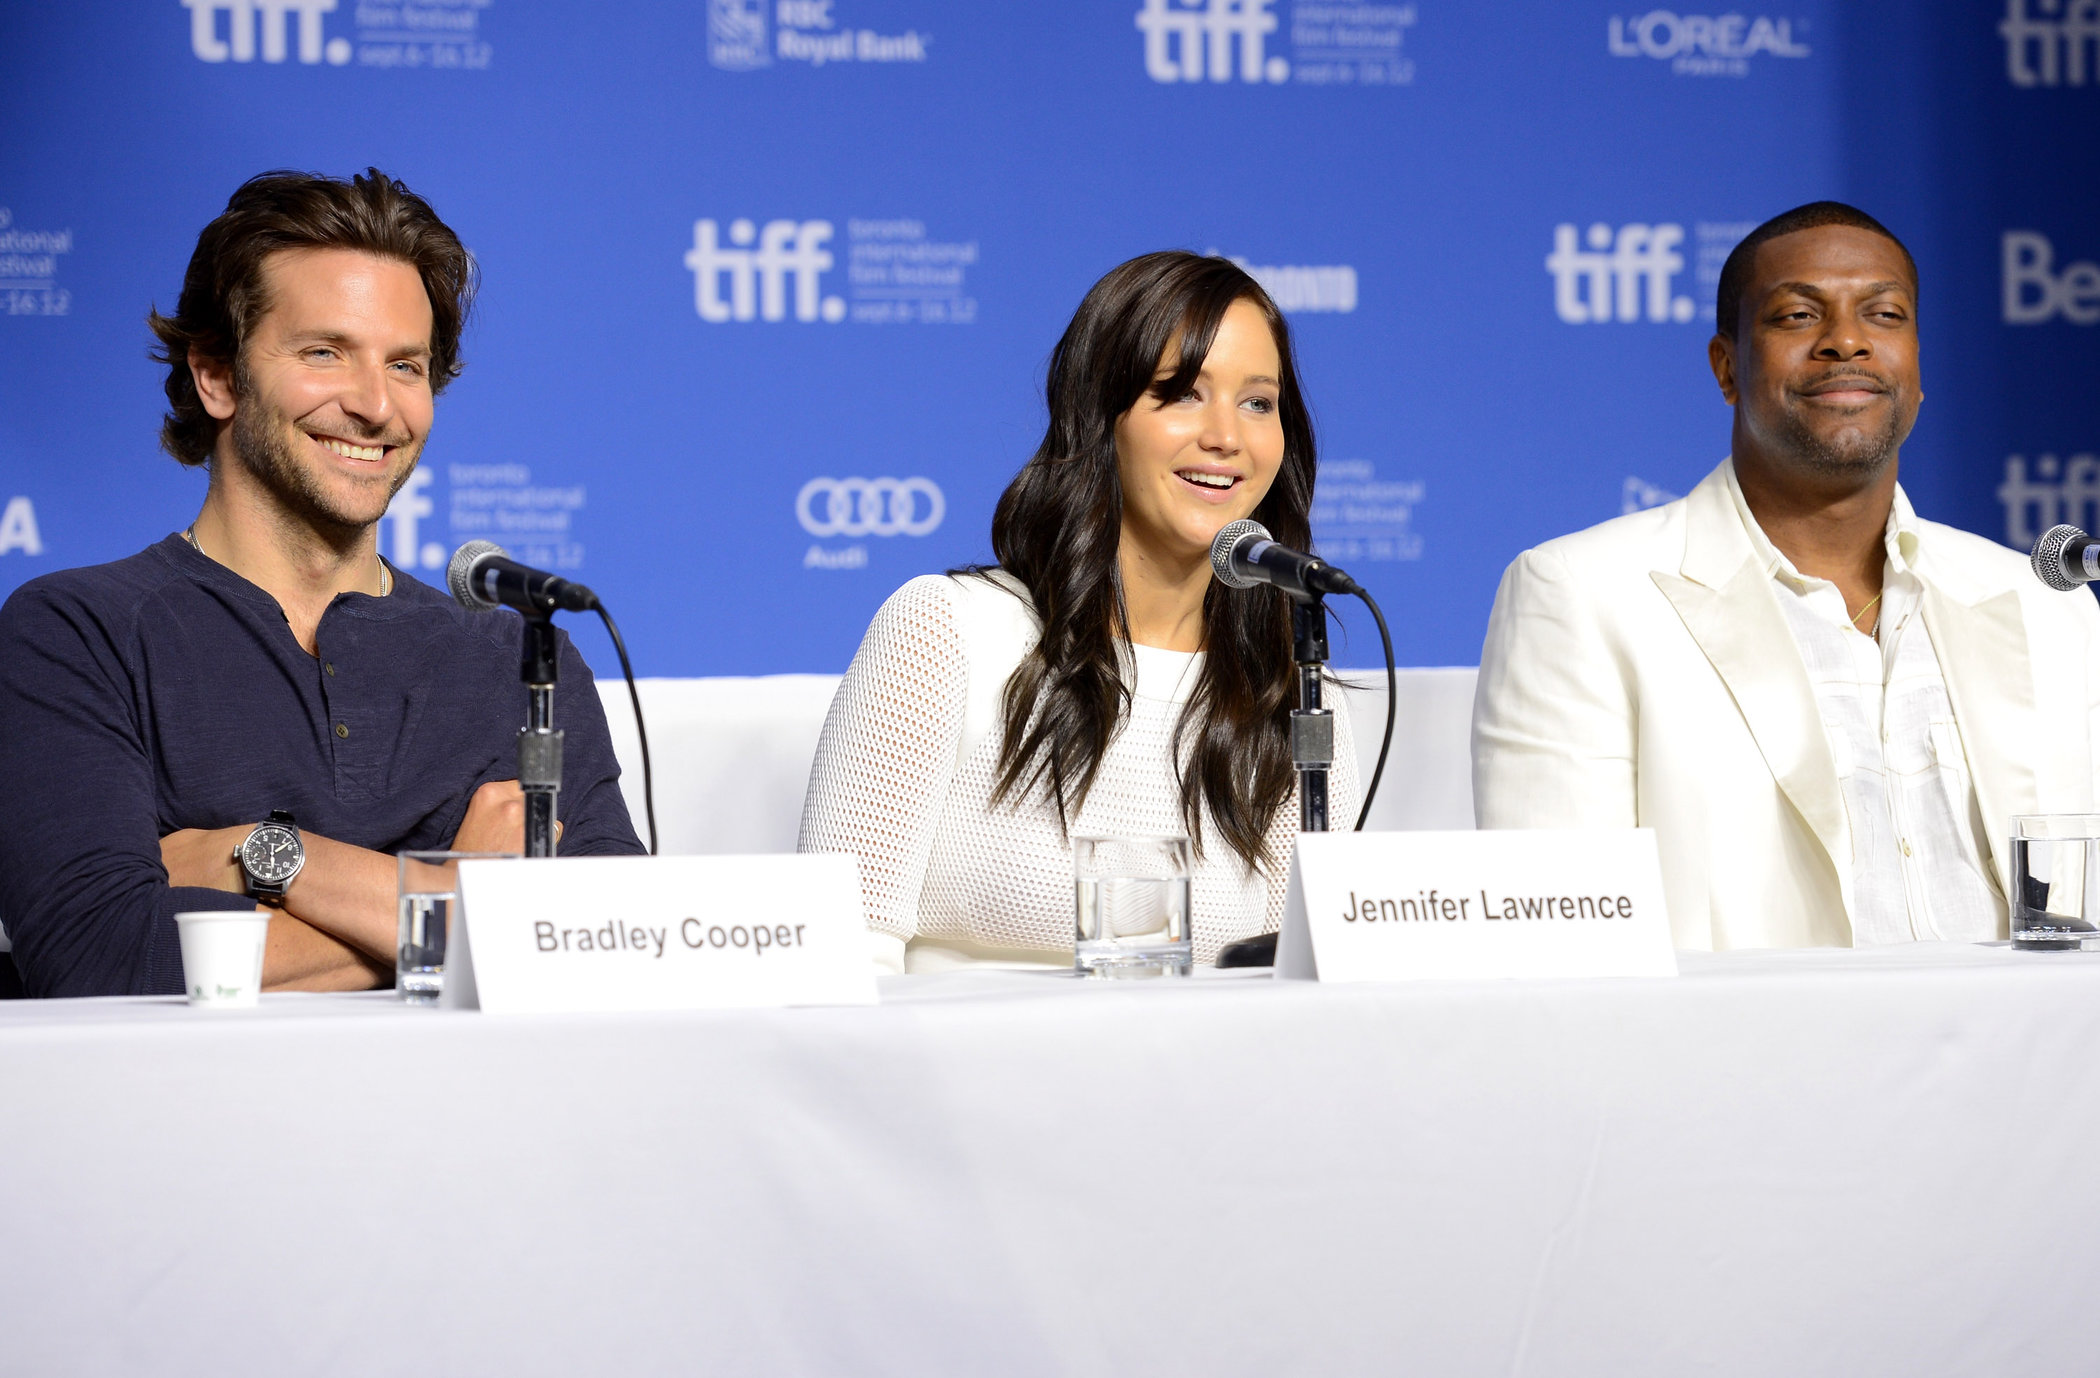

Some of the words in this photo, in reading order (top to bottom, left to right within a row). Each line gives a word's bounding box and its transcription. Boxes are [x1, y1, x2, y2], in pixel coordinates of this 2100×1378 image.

[777, 29, 854, 66] Royal
[856, 29, 928, 62] Bank
[1135, 0, 1290, 84] tiff.
[1997, 0, 2100, 87] tif
[684, 218, 847, 323] tiff.
[1545, 222, 1695, 325] tiff.
[803, 545, 868, 569] Audi
[1343, 889, 1470, 923] Jennifer
[1481, 889, 1633, 921] Lawrence
[534, 919, 667, 960] Bradley
[681, 917, 806, 956] Cooper
